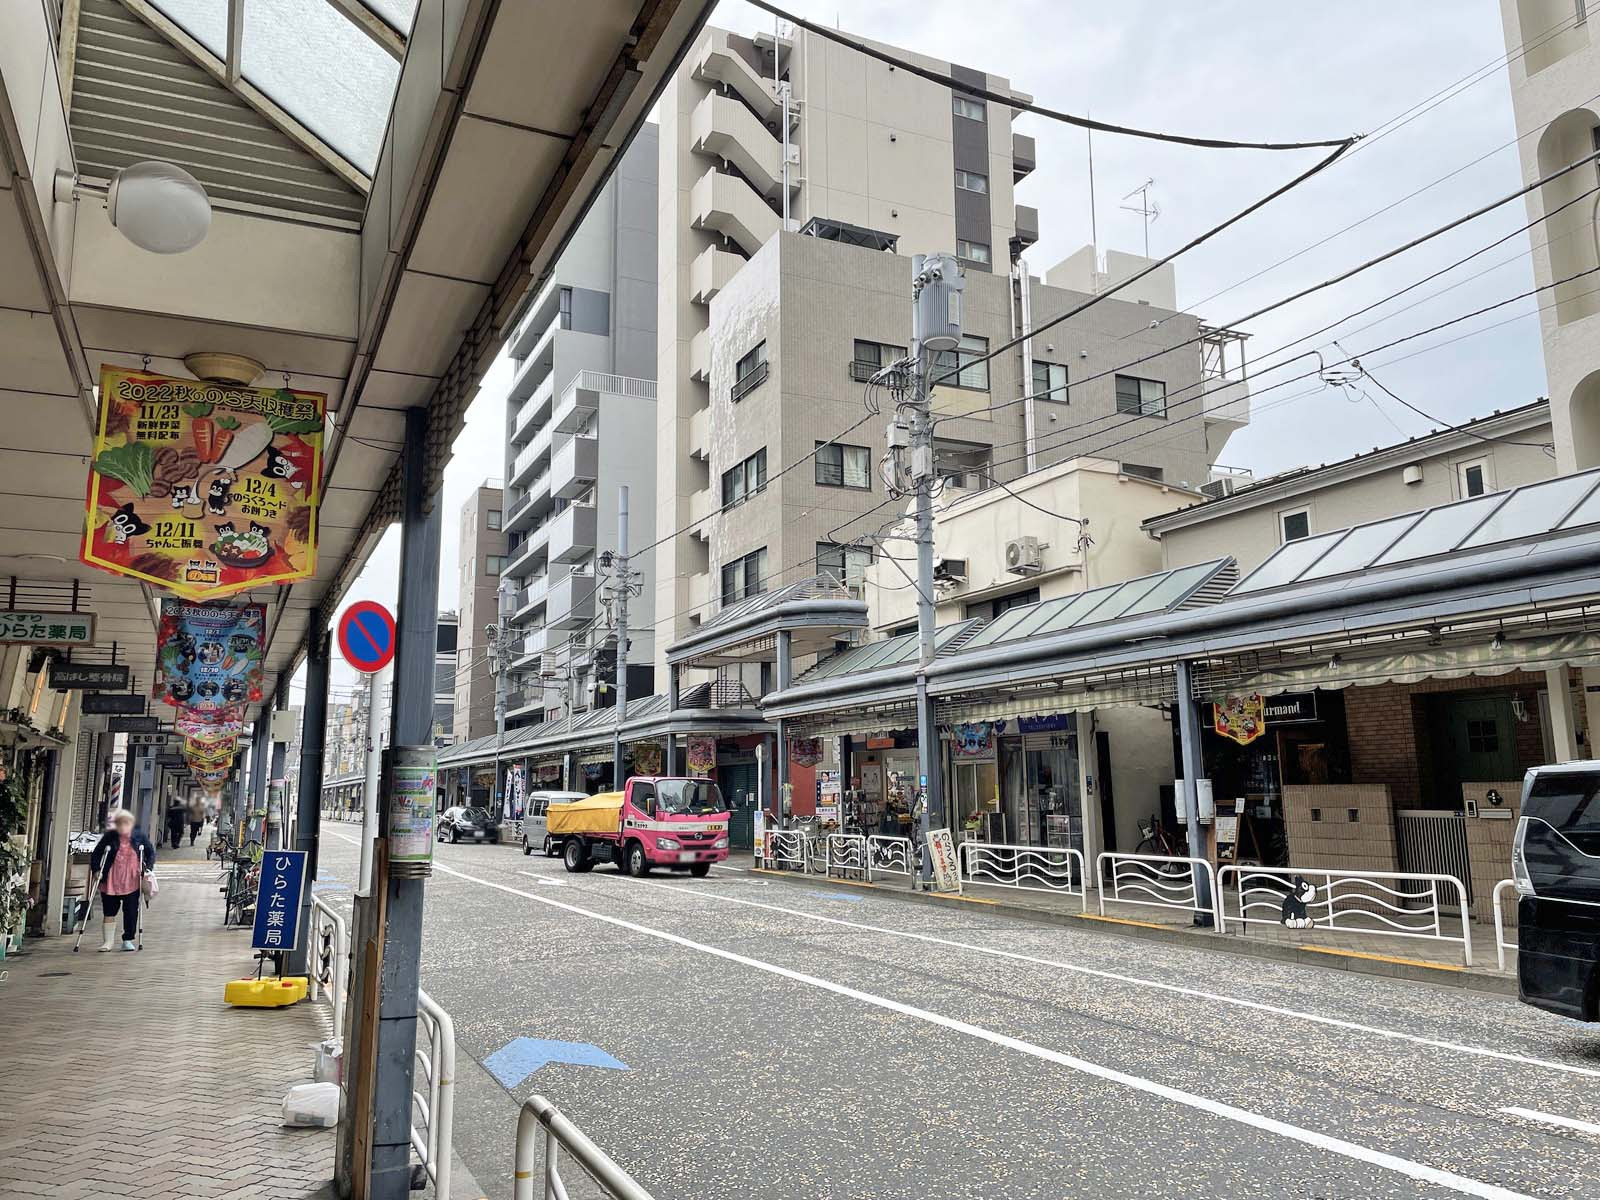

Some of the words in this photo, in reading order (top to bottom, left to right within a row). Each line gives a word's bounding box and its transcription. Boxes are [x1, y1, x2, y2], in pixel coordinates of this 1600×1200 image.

[139, 405, 180, 420] 11/23
[245, 478, 276, 497] 12/4
[241, 504, 277, 519] お餅つき
[155, 522, 195, 537] 12/11
[3, 614, 42, 622] くすり
[0, 623, 86, 640] ひらた薬局
[264, 856, 292, 946] ひらた薬局
